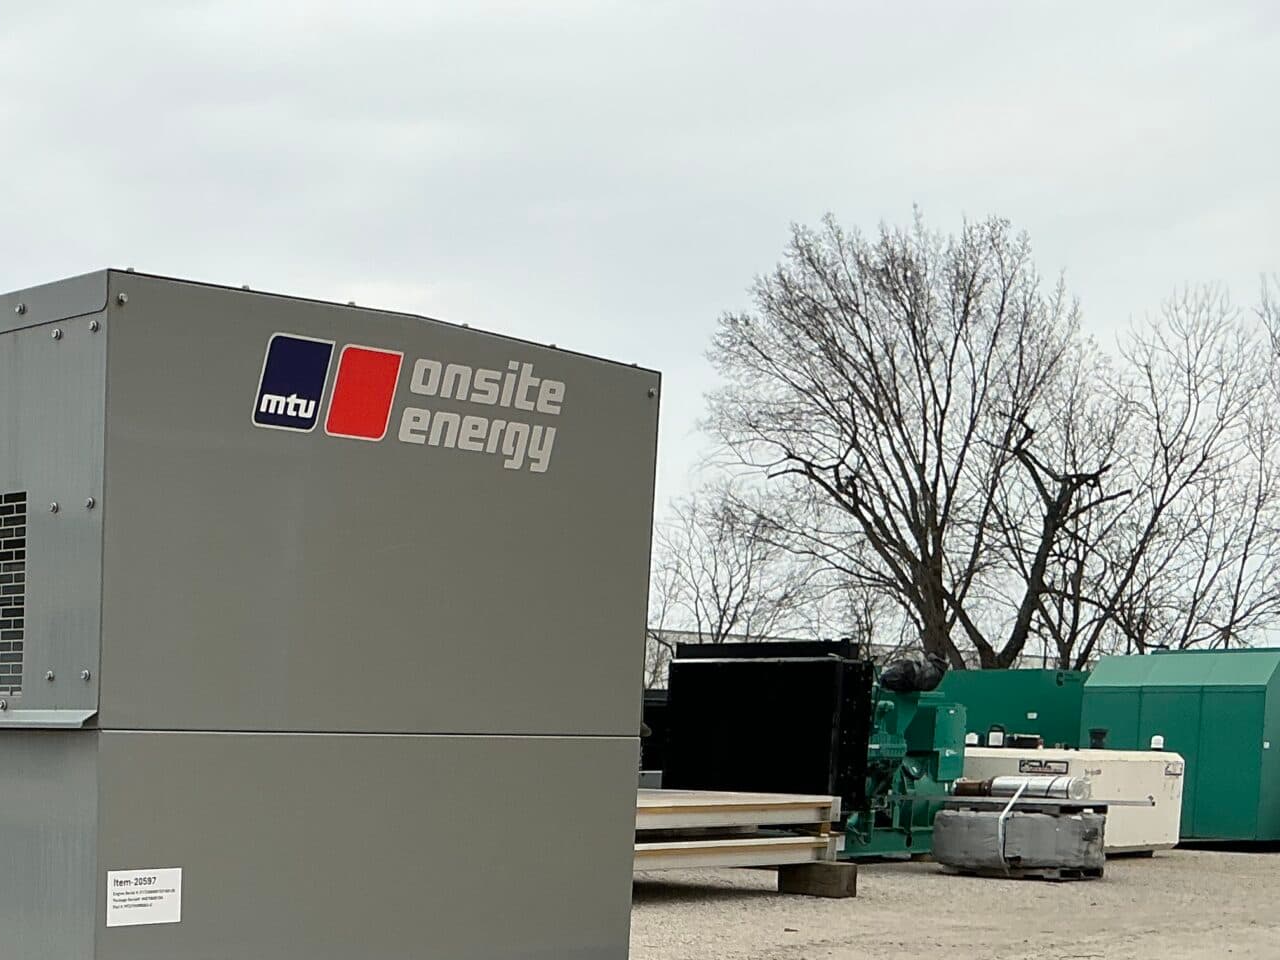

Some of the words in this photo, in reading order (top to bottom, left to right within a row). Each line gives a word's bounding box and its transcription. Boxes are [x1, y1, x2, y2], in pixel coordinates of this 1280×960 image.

[259, 393, 316, 419] mtu
[409, 360, 566, 416] onsite
[398, 406, 557, 473] energy
